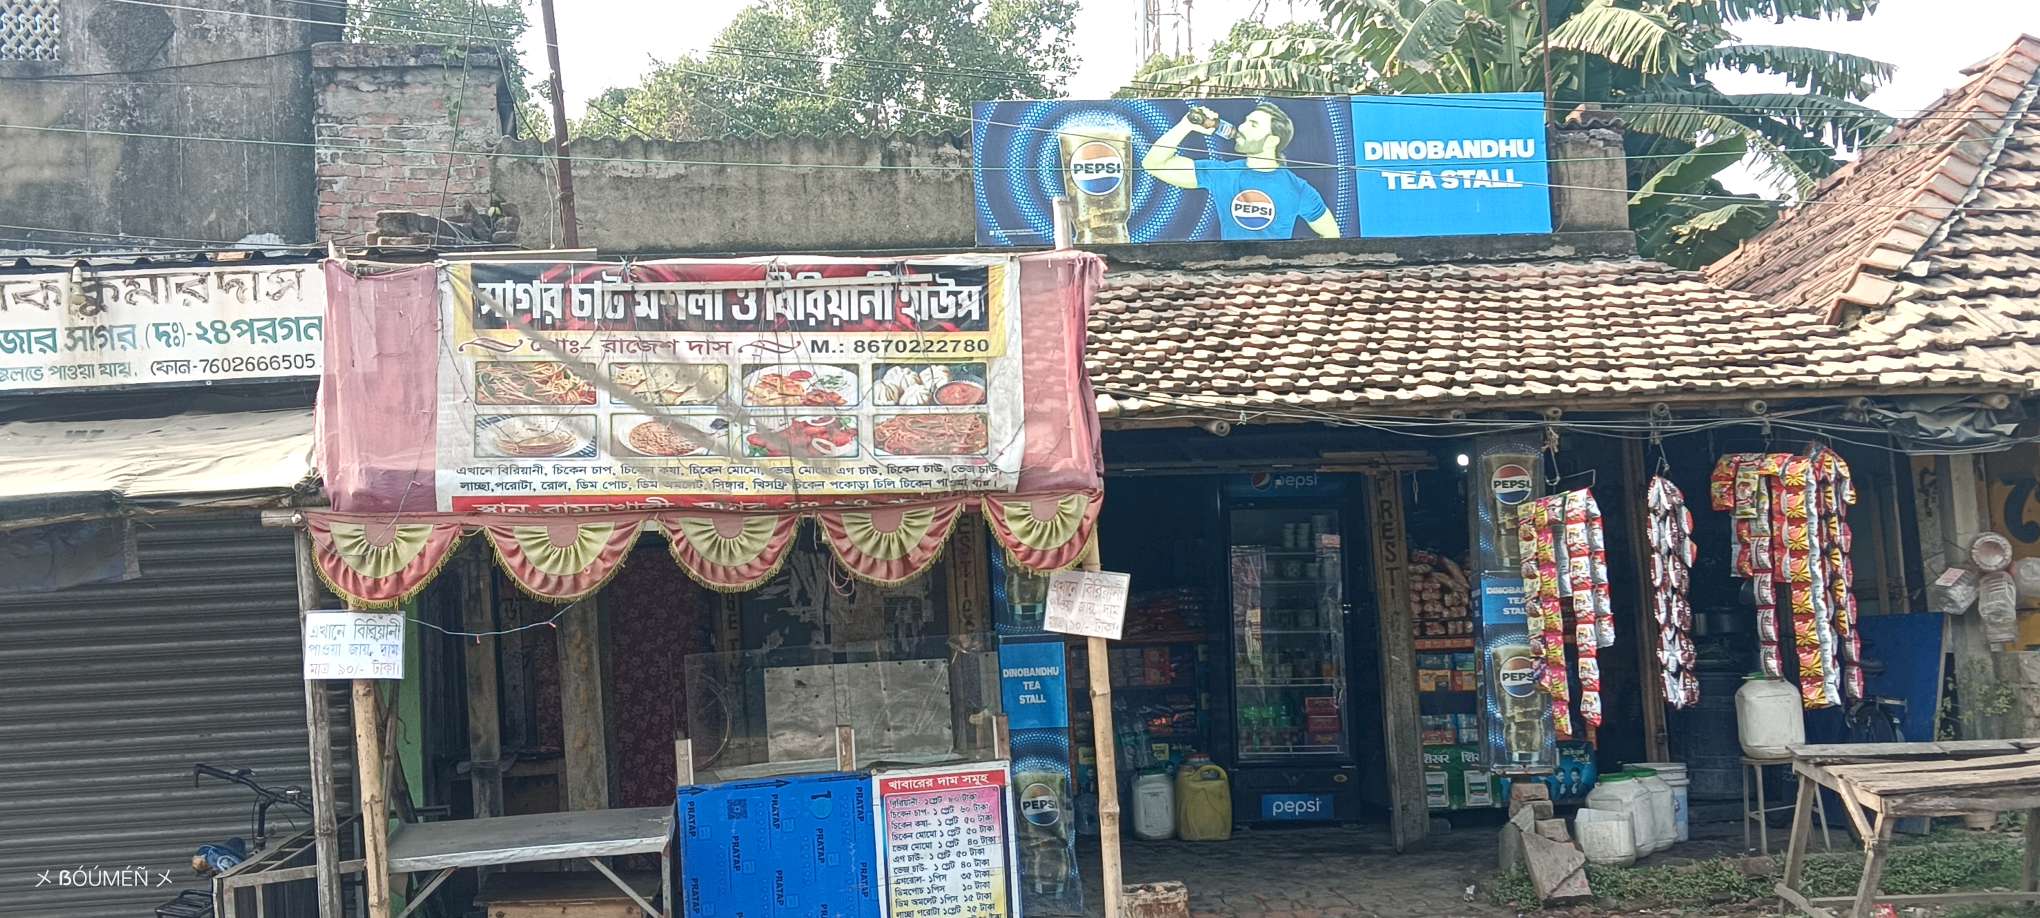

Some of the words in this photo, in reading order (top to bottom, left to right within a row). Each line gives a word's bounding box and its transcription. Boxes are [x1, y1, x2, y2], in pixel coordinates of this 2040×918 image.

[1364, 139, 1536, 161] DINOBANDHU
[1073, 162, 1121, 175] PEPSI
[1381, 170, 1437, 190] TEA
[1441, 168, 1524, 190] STALL
[1234, 203, 1272, 217] PEPSI
[478, 280, 564, 324] সাগর
[64, 325, 137, 353] সাগর
[600, 338, 679, 355] রাজেশ
[686, 339, 733, 355] দাস
[853, 338, 989, 355] 8670222780
[456, 465, 493, 476] এখানে
[553, 464, 587, 476] চিকেন
[1002, 666, 1060, 678] DINOBANDHU
[1022, 681, 1041, 691] TEA
[1019, 694, 1047, 705] STALL
[887, 778, 934, 791] খাবারের
[936, 776, 960, 786] দাম
[771, 793, 781, 830] PRATAP
[856, 786, 865, 822] PRATAP
[1272, 797, 1320, 816] pepsi
[687, 801, 697, 838] PRATAP
[815, 827, 825, 865] PRATAP
[690, 877, 700, 915] PRATAP
[775, 869, 785, 906] PRATAP
